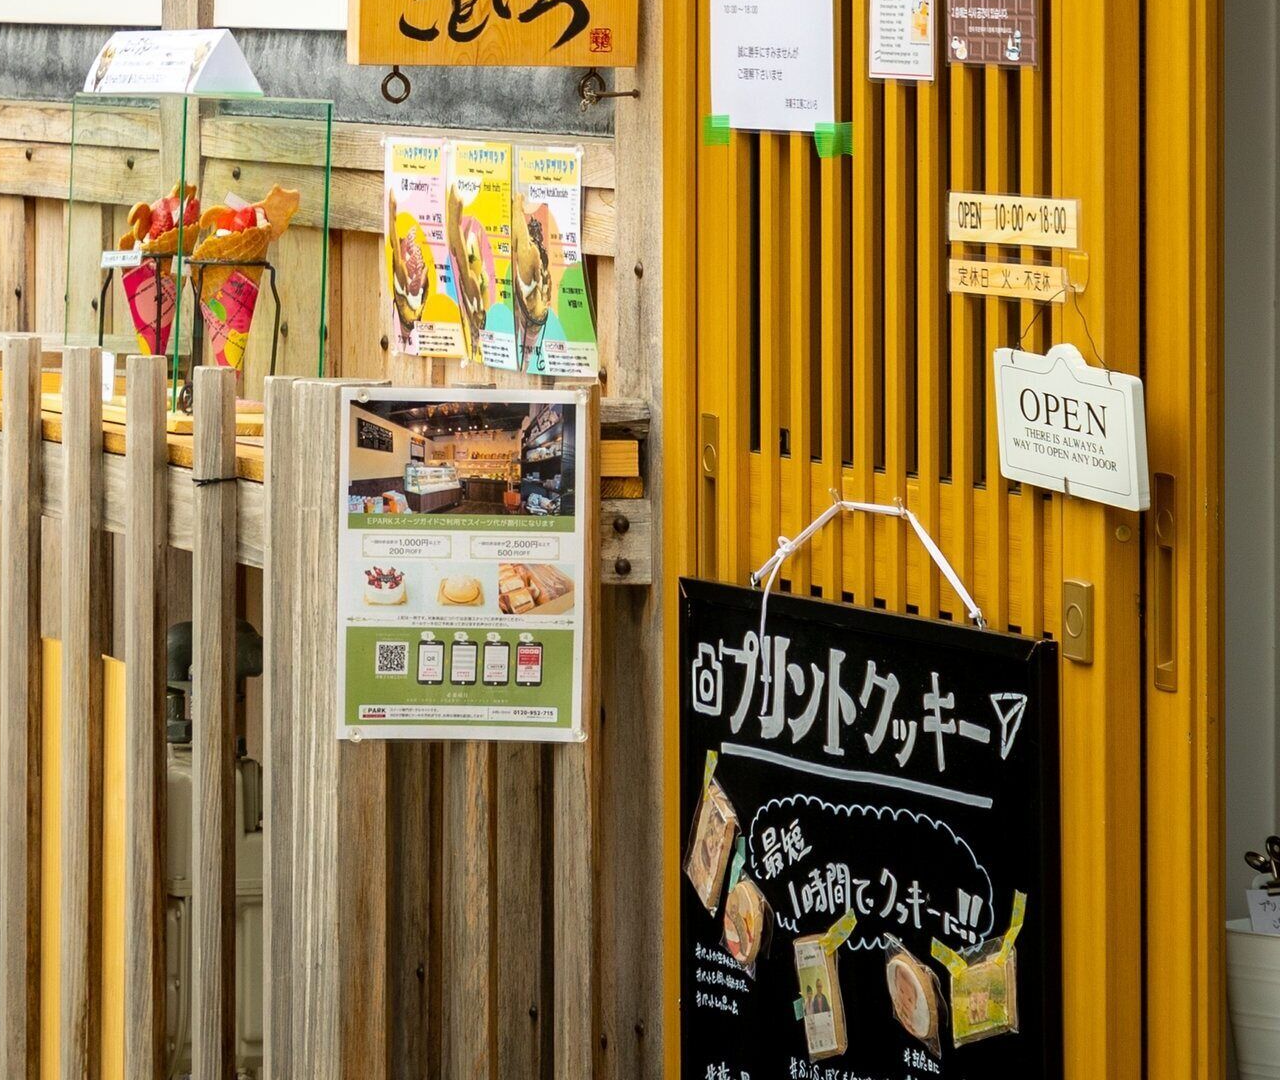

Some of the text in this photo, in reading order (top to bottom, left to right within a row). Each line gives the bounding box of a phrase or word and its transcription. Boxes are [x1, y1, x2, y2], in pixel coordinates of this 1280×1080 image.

[957, 201, 982, 230] OPEN
[958, 268, 990, 289] 定休日
[1020, 388, 1107, 439] OPEN
[1012, 437, 1118, 472] WAY TO OPEN ANY DOOR
[1025, 426, 1105, 455] THERE IS ALWAYS A
[720, 630, 991, 772] プリントクッキー
[761, 819, 813, 880] 最短
